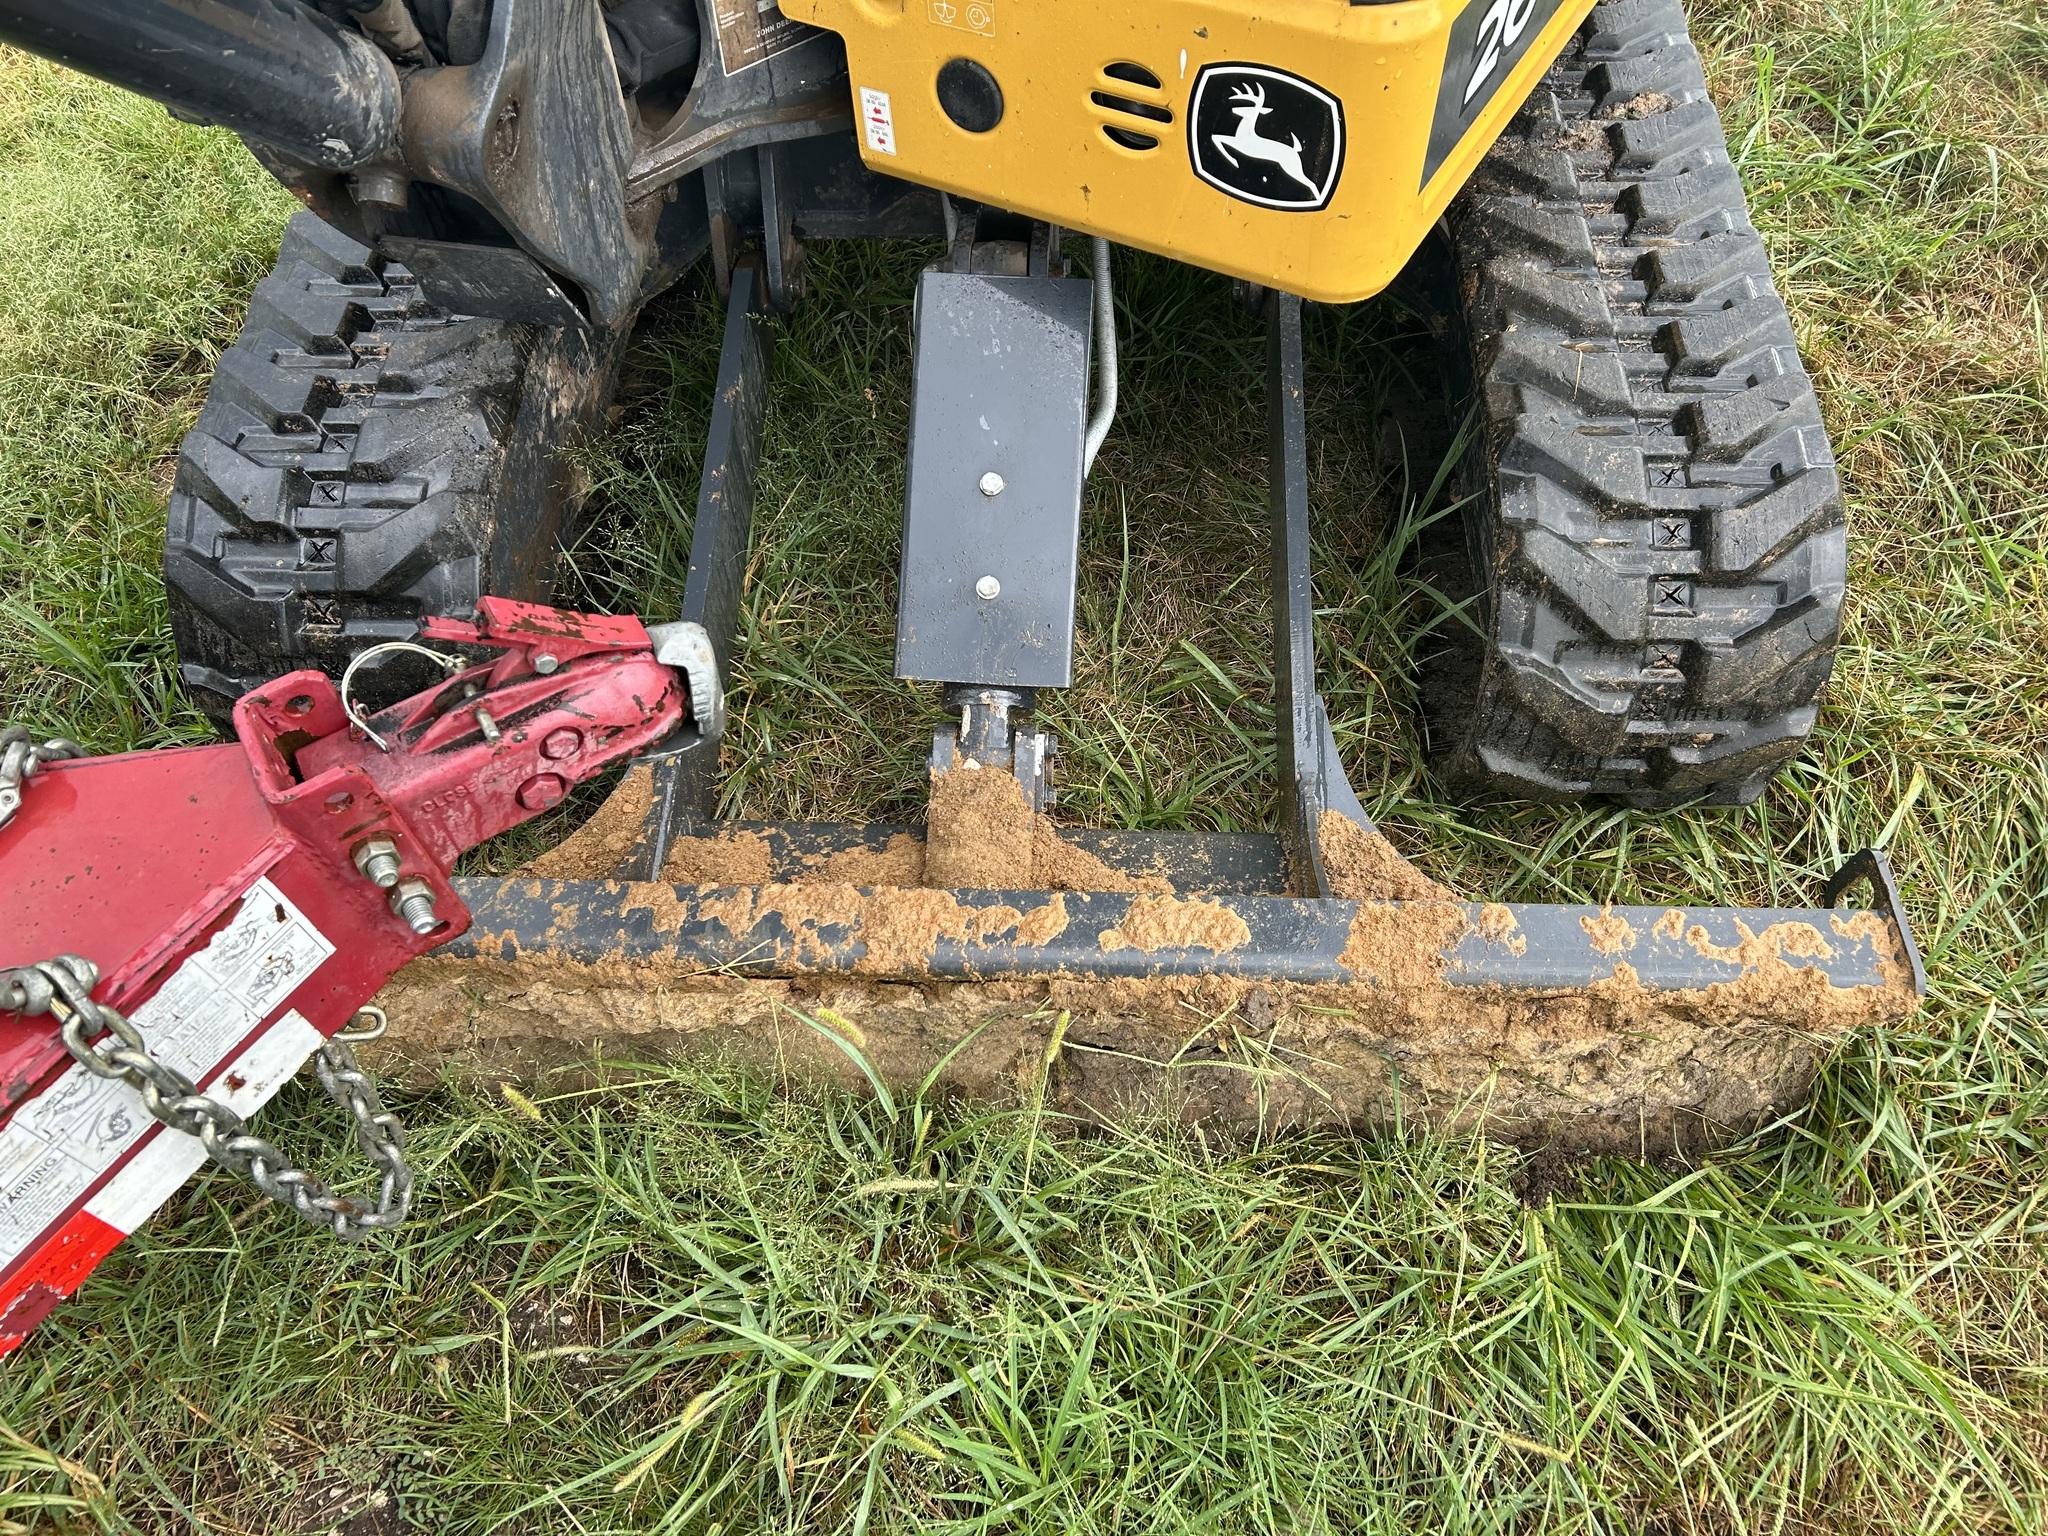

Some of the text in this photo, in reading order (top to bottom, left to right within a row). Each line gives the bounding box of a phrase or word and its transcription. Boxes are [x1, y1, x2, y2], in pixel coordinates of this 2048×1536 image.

[756, 25, 775, 38] JOHN
[776, 19, 794, 29] DEE
[421, 780, 478, 813] CLOSE
